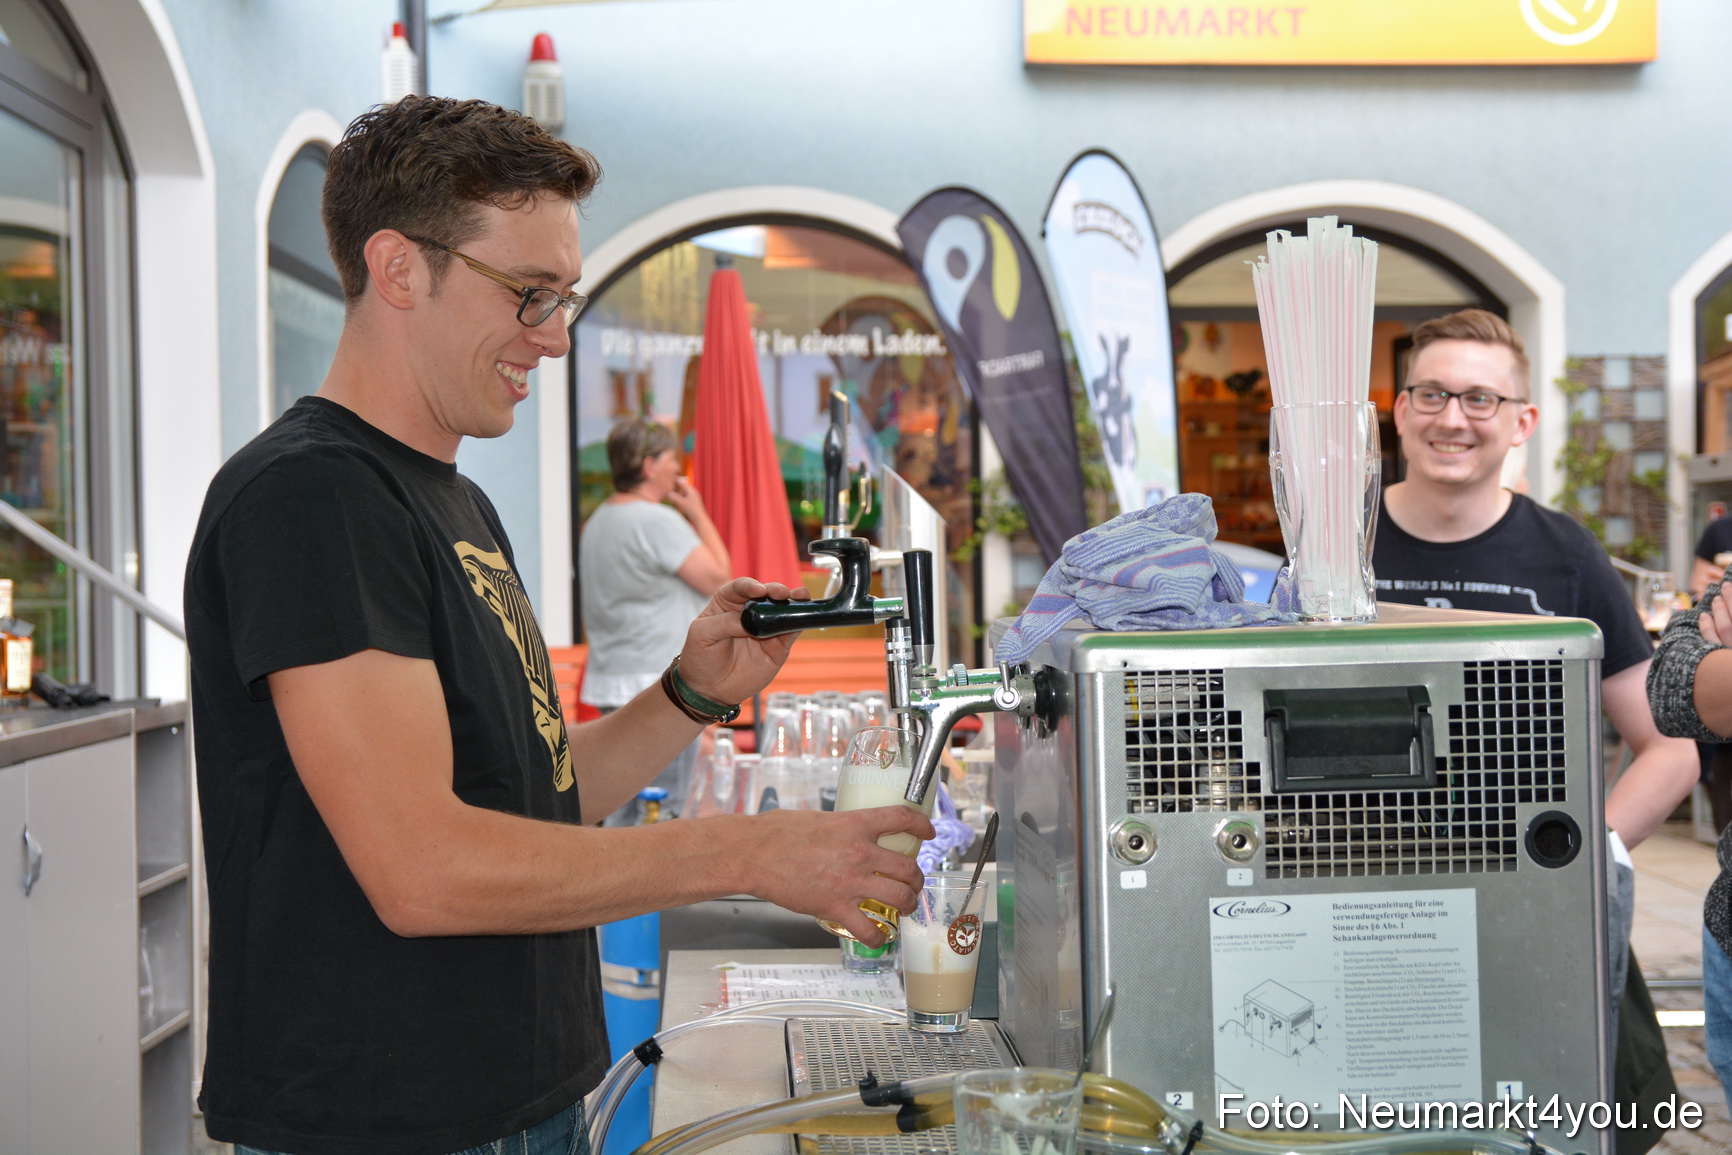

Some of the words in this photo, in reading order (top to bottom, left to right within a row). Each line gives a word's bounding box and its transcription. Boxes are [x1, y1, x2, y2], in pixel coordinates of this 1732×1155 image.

[1066, 7, 1305, 37] NEUMARKT
[872, 326, 947, 356] Laden.
[1332, 901, 1414, 911] Bedienungsanleitung
[1415, 900, 1428, 908] für
[1428, 899, 1445, 907] eine
[1332, 912, 1409, 921] verwendungsfertige
[1410, 910, 1436, 919] Anlage
[1438, 909, 1448, 917] im
[1332, 923, 1355, 932] Sinne
[1356, 923, 1369, 931] des
[1382, 922, 1399, 930] Abs.
[1332, 931, 1437, 942] Schankanlagenverordnung
[1504, 1084, 1512, 1096] 1
[1173, 1094, 1182, 1106] 2
